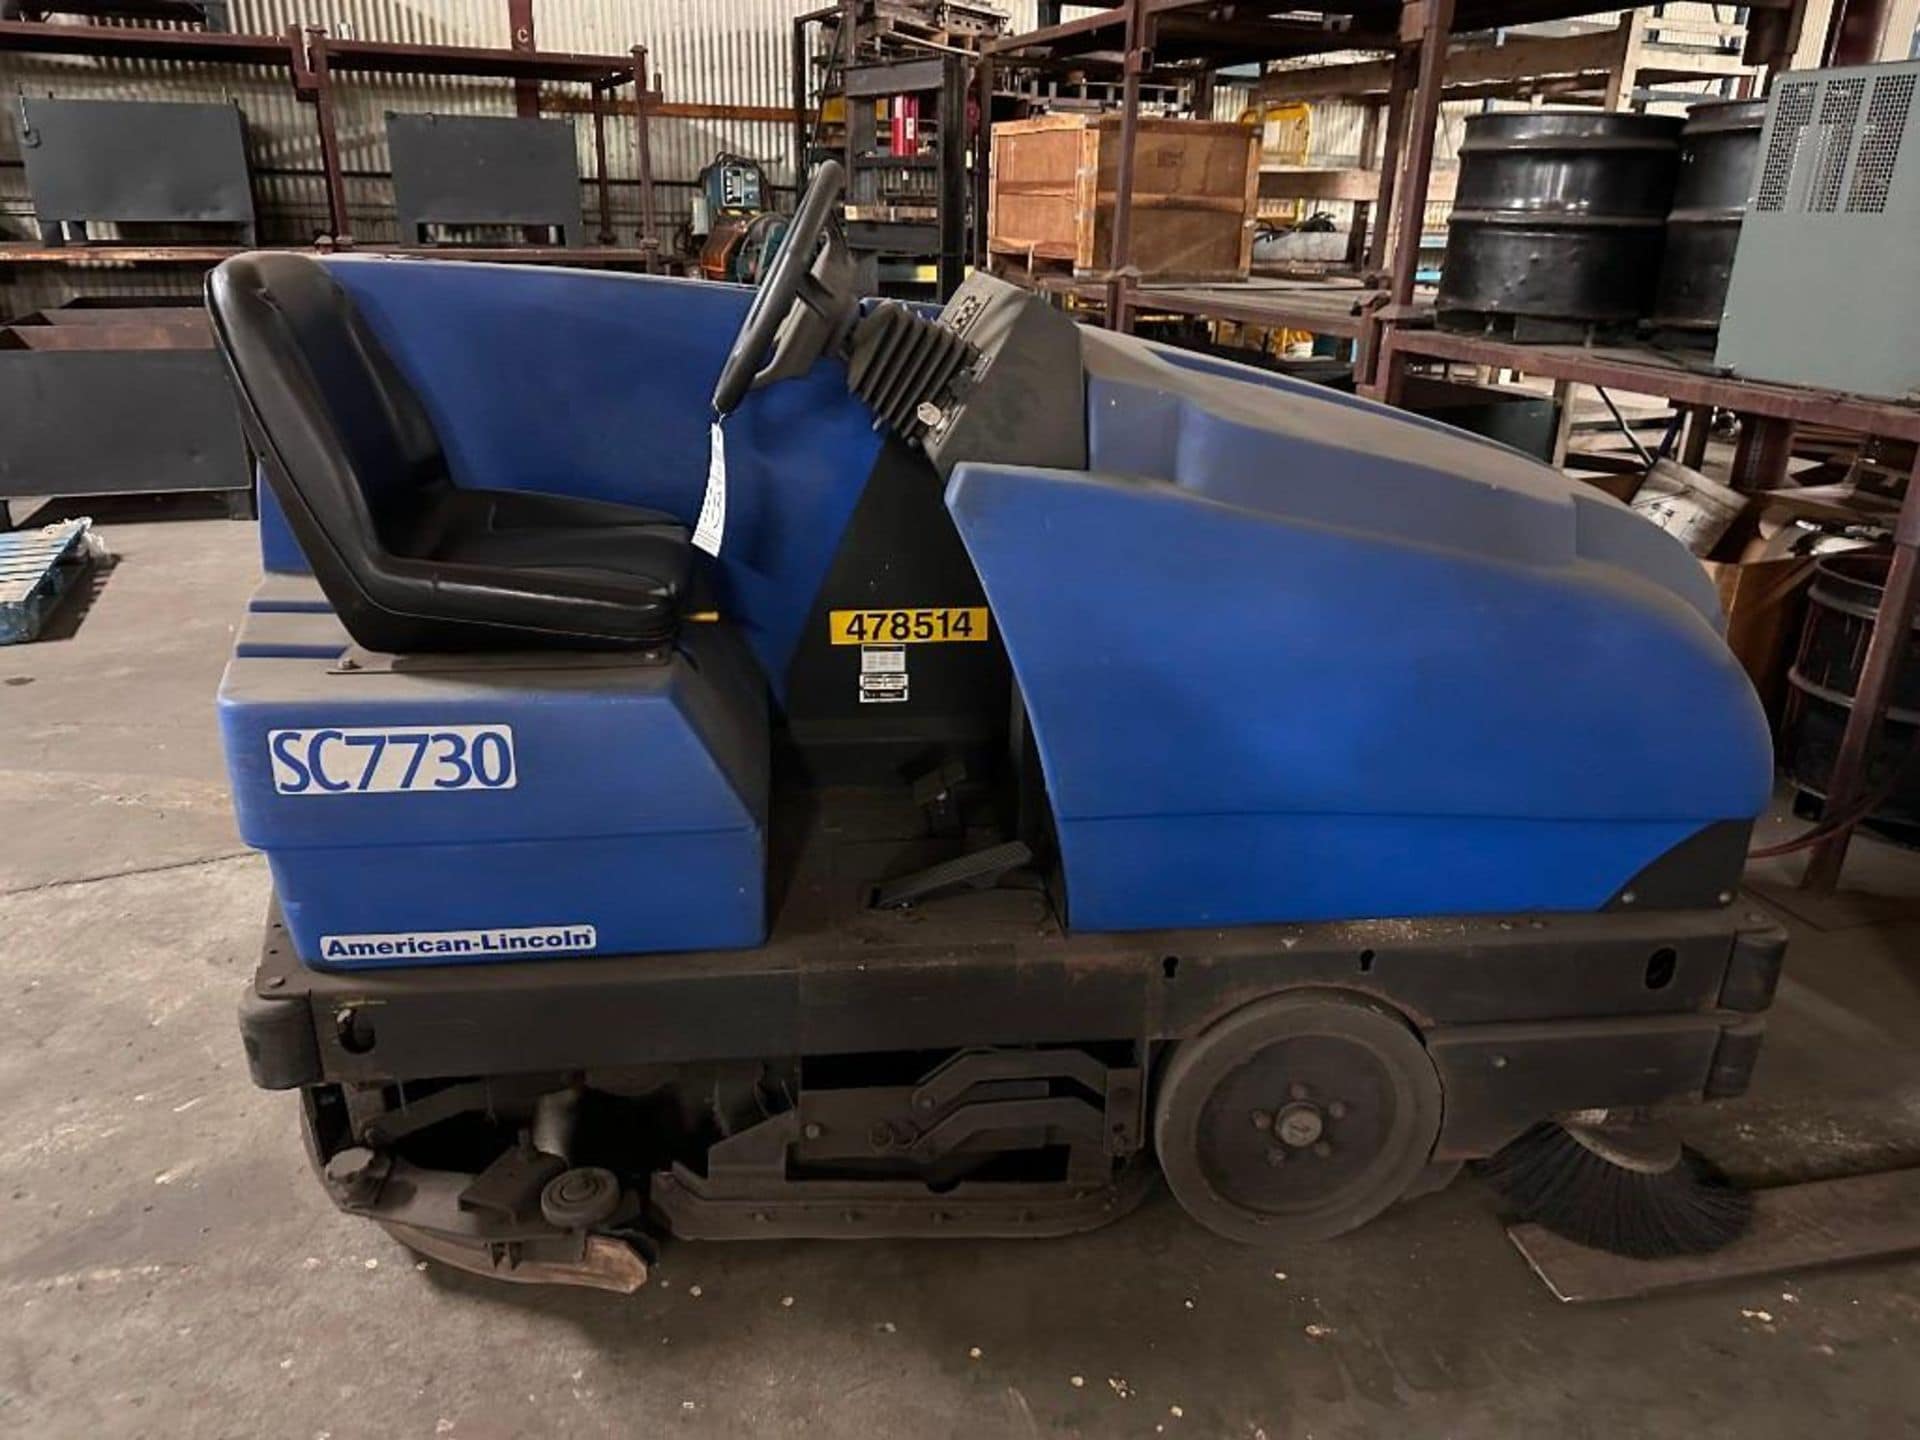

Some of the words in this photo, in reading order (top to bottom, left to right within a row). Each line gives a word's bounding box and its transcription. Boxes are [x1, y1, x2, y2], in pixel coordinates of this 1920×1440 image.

[846, 611, 973, 640] 478514
[273, 730, 512, 792] SC7730
[327, 930, 592, 956] American-Lincoln
